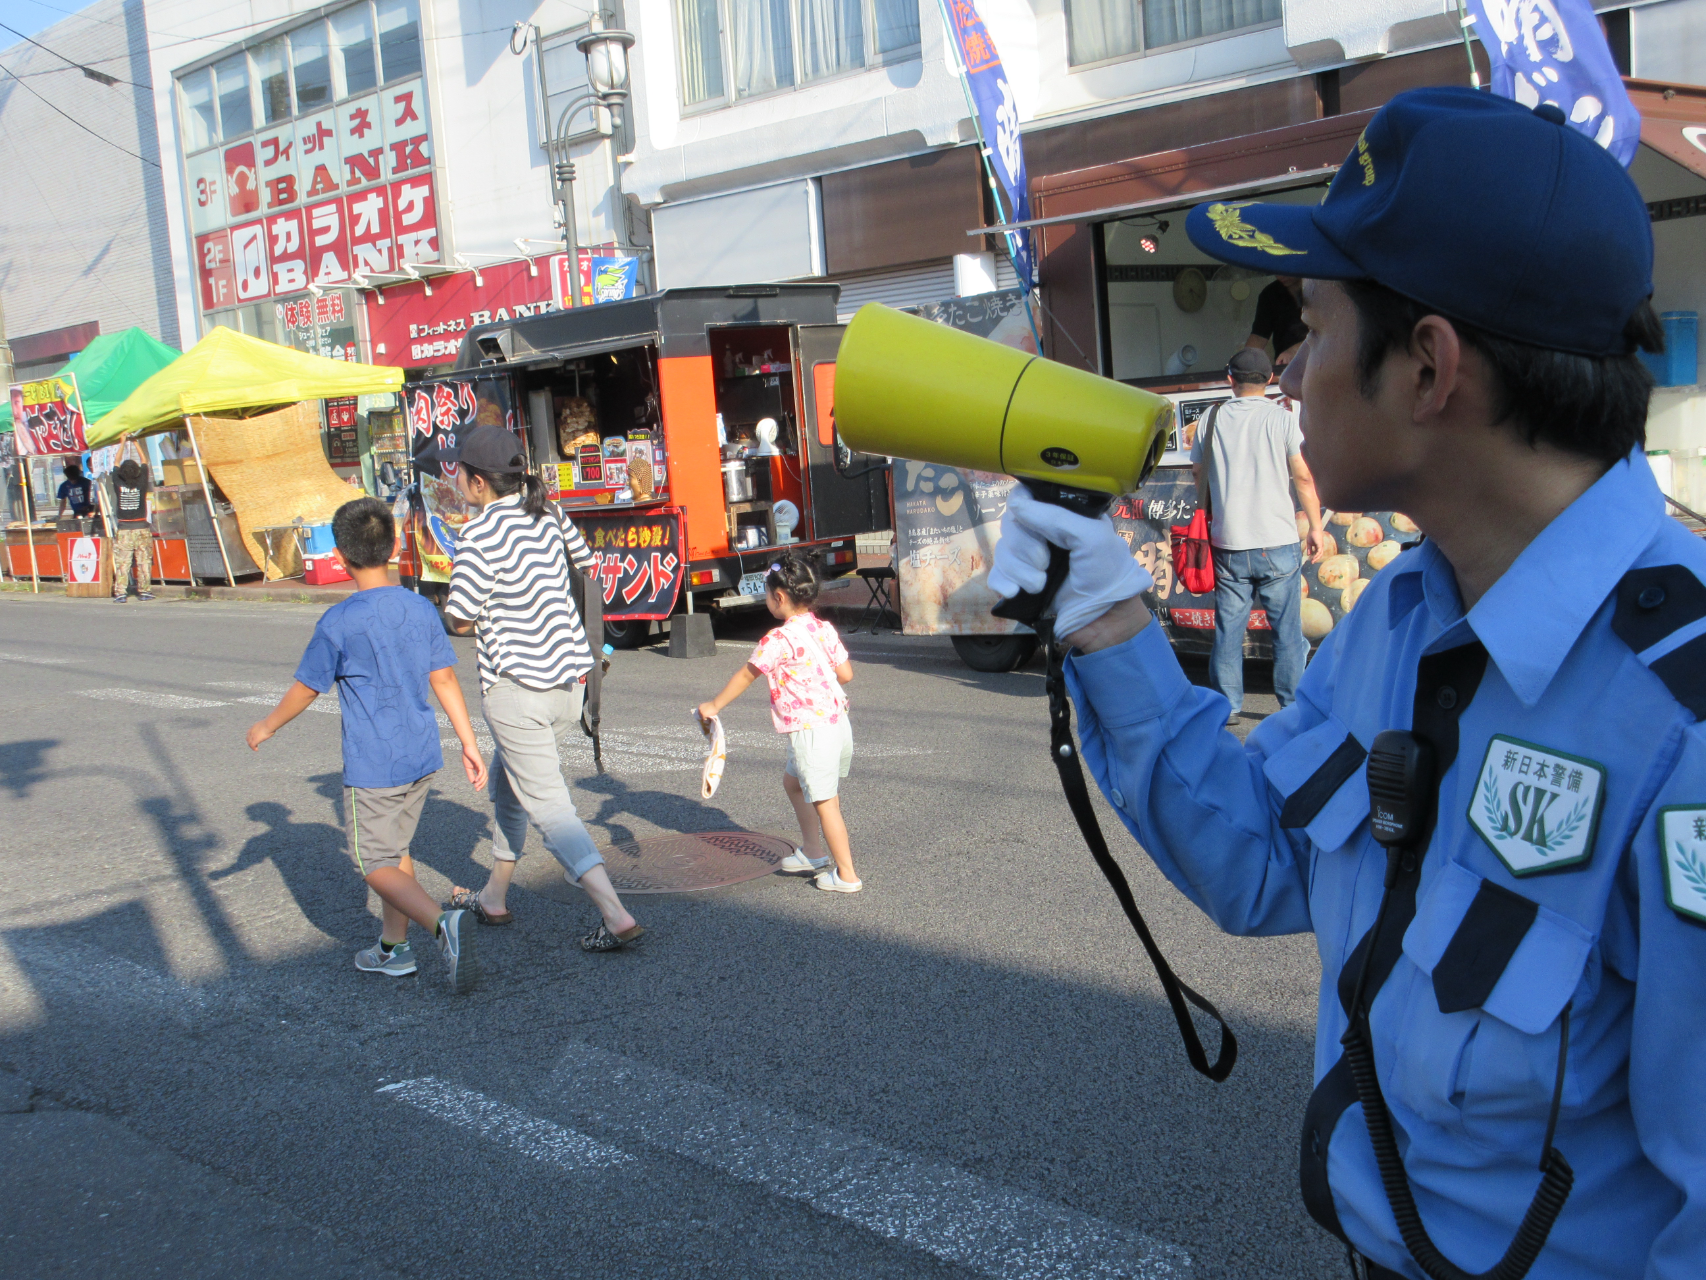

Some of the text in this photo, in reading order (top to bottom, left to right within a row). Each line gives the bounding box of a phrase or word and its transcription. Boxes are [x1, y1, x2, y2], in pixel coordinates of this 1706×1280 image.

[261, 91, 418, 168] フィットネス
[196, 176, 217, 208] 3F
[265, 134, 431, 209] BANK
[272, 183, 430, 257] カラオケ
[203, 241, 224, 270] 2F
[273, 227, 440, 294] BANK
[208, 276, 228, 304] 1F
[284, 292, 345, 331] 体験無料
[419, 319, 467, 337] フィットネス
[470, 300, 557, 326] BANK
[411, 382, 477, 438] 肉祭り
[909, 547, 962, 568] 塩チーズ
[1501, 749, 1583, 793] 新日本警備
[1500, 781, 1560, 848] SK
